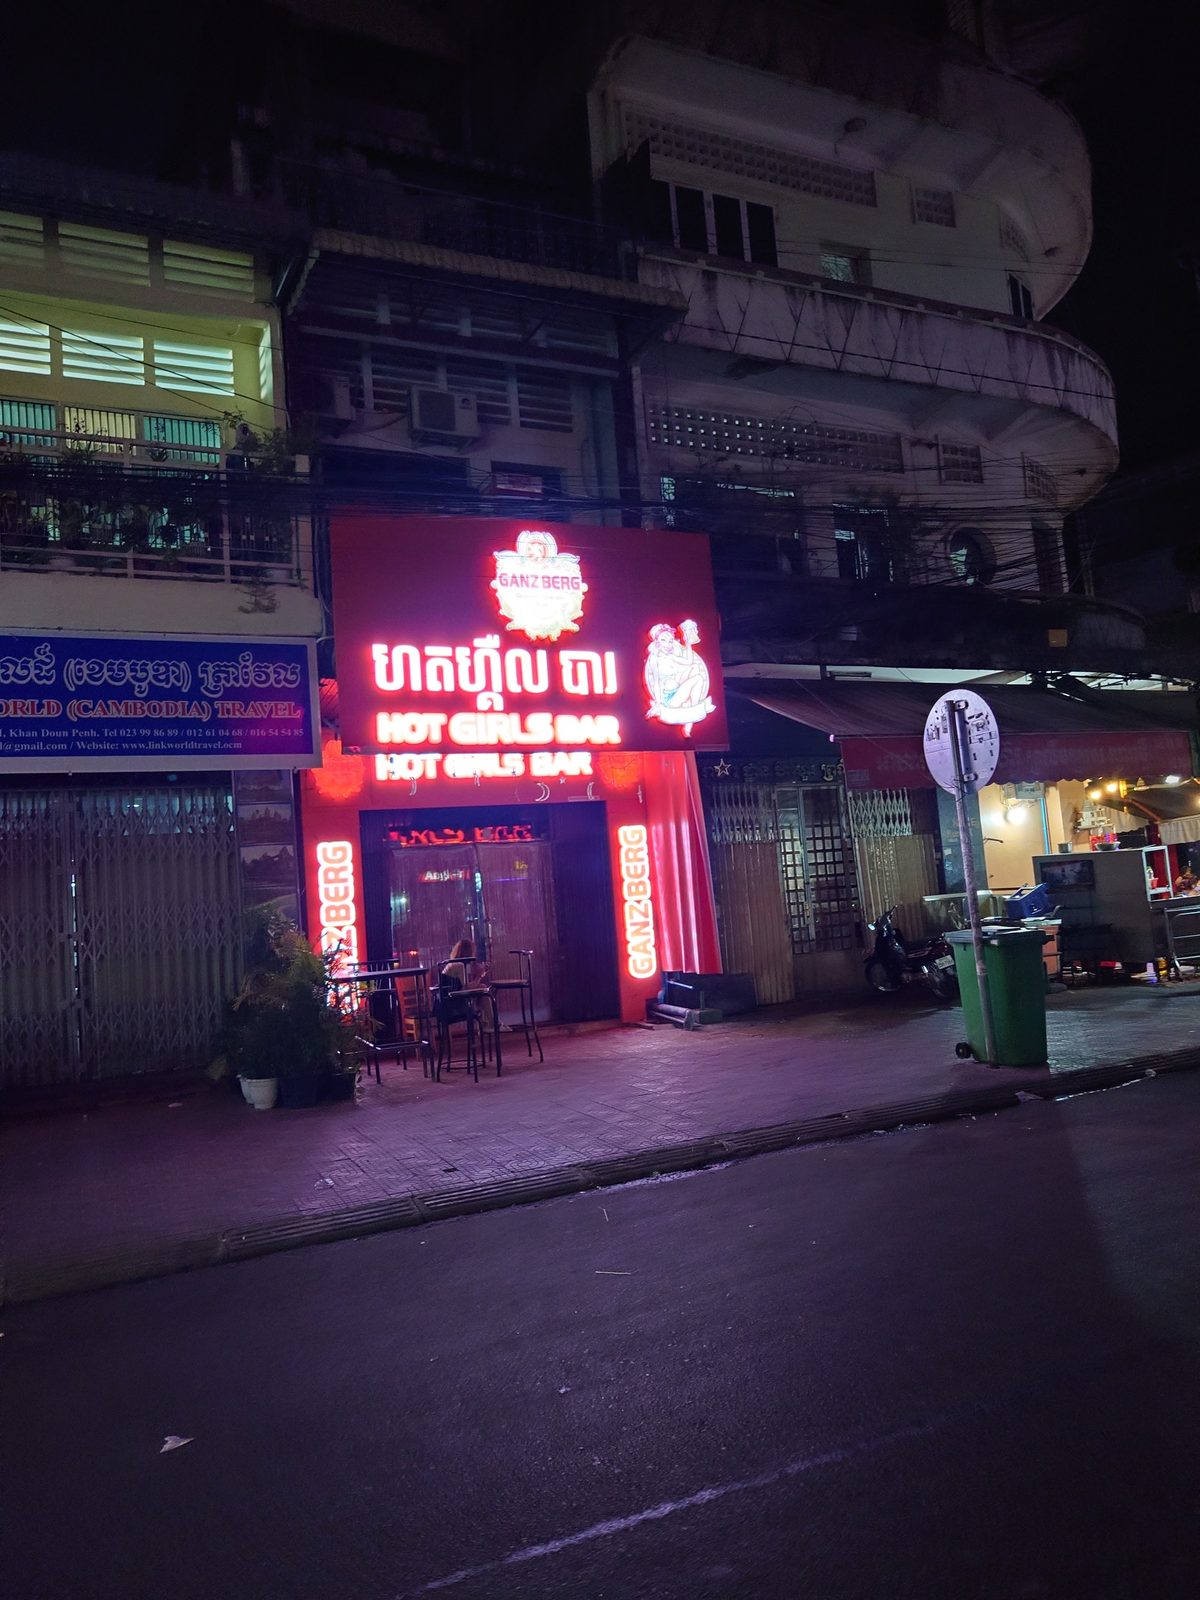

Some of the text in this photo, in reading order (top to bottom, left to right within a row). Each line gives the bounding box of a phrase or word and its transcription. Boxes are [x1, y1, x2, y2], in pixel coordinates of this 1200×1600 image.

[66, 699, 212, 721] (CAMBODIA)
[214, 700, 302, 718] TRAVEL
[9, 728, 38, 738] Khan
[41, 728, 69, 738] Doun
[72, 728, 100, 738] Penh.
[102, 728, 118, 738] Tel
[120, 728, 137, 738] 023
[139, 728, 151, 738] 99
[153, 728, 165, 738] 86
[167, 728, 178, 738] 89
[186, 728, 202, 738] 012
[205, 728, 215, 738] 61
[218, 728, 229, 738] 04
[231, 728, 243, 738] 68
[250, 728, 266, 738] 016
[268, 728, 279, 738] 54
[280, 728, 292, 738] 54
[293, 728, 304, 738] 85
[376, 712, 447, 744] HOT
[555, 715, 621, 744] BAR
[76, 741, 119, 751] Website:
[375, 753, 442, 781] HOT
[530, 752, 593, 777] BAR
